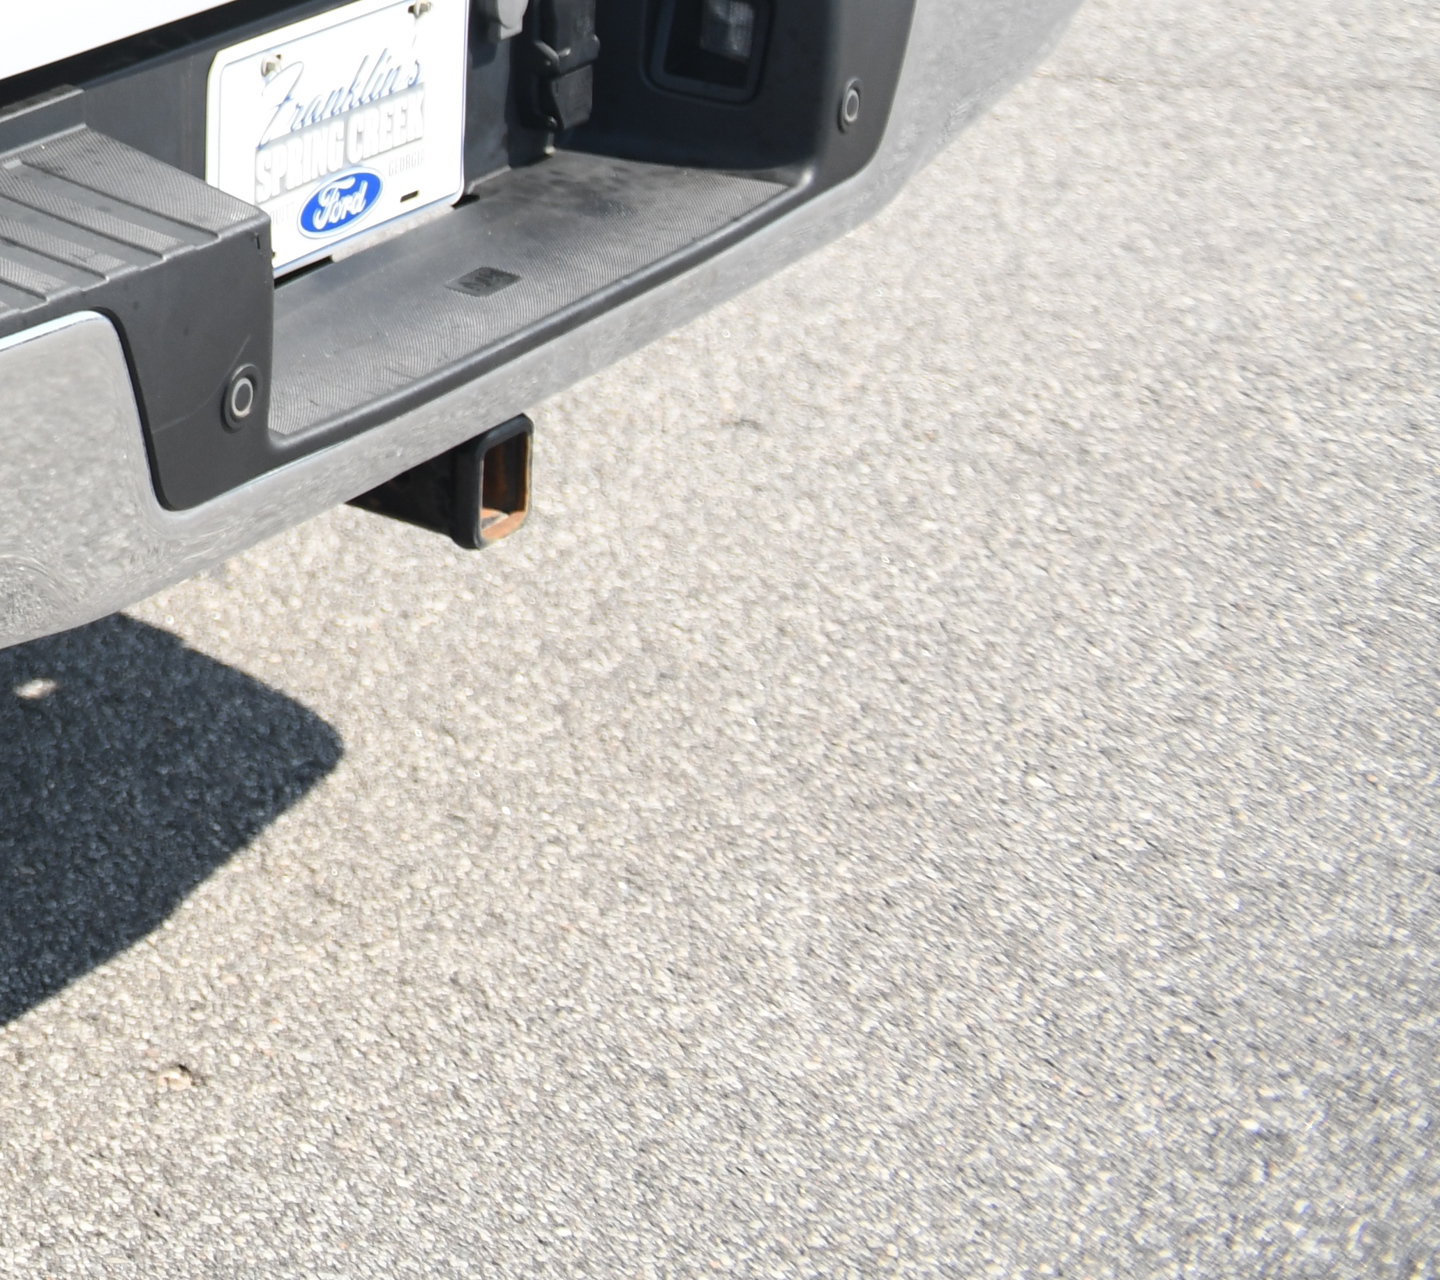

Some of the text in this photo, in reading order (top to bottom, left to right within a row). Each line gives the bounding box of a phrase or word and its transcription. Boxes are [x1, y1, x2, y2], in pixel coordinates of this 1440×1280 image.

[255, 95, 425, 204] SPRING CREEK
[311, 176, 369, 231] Ford
